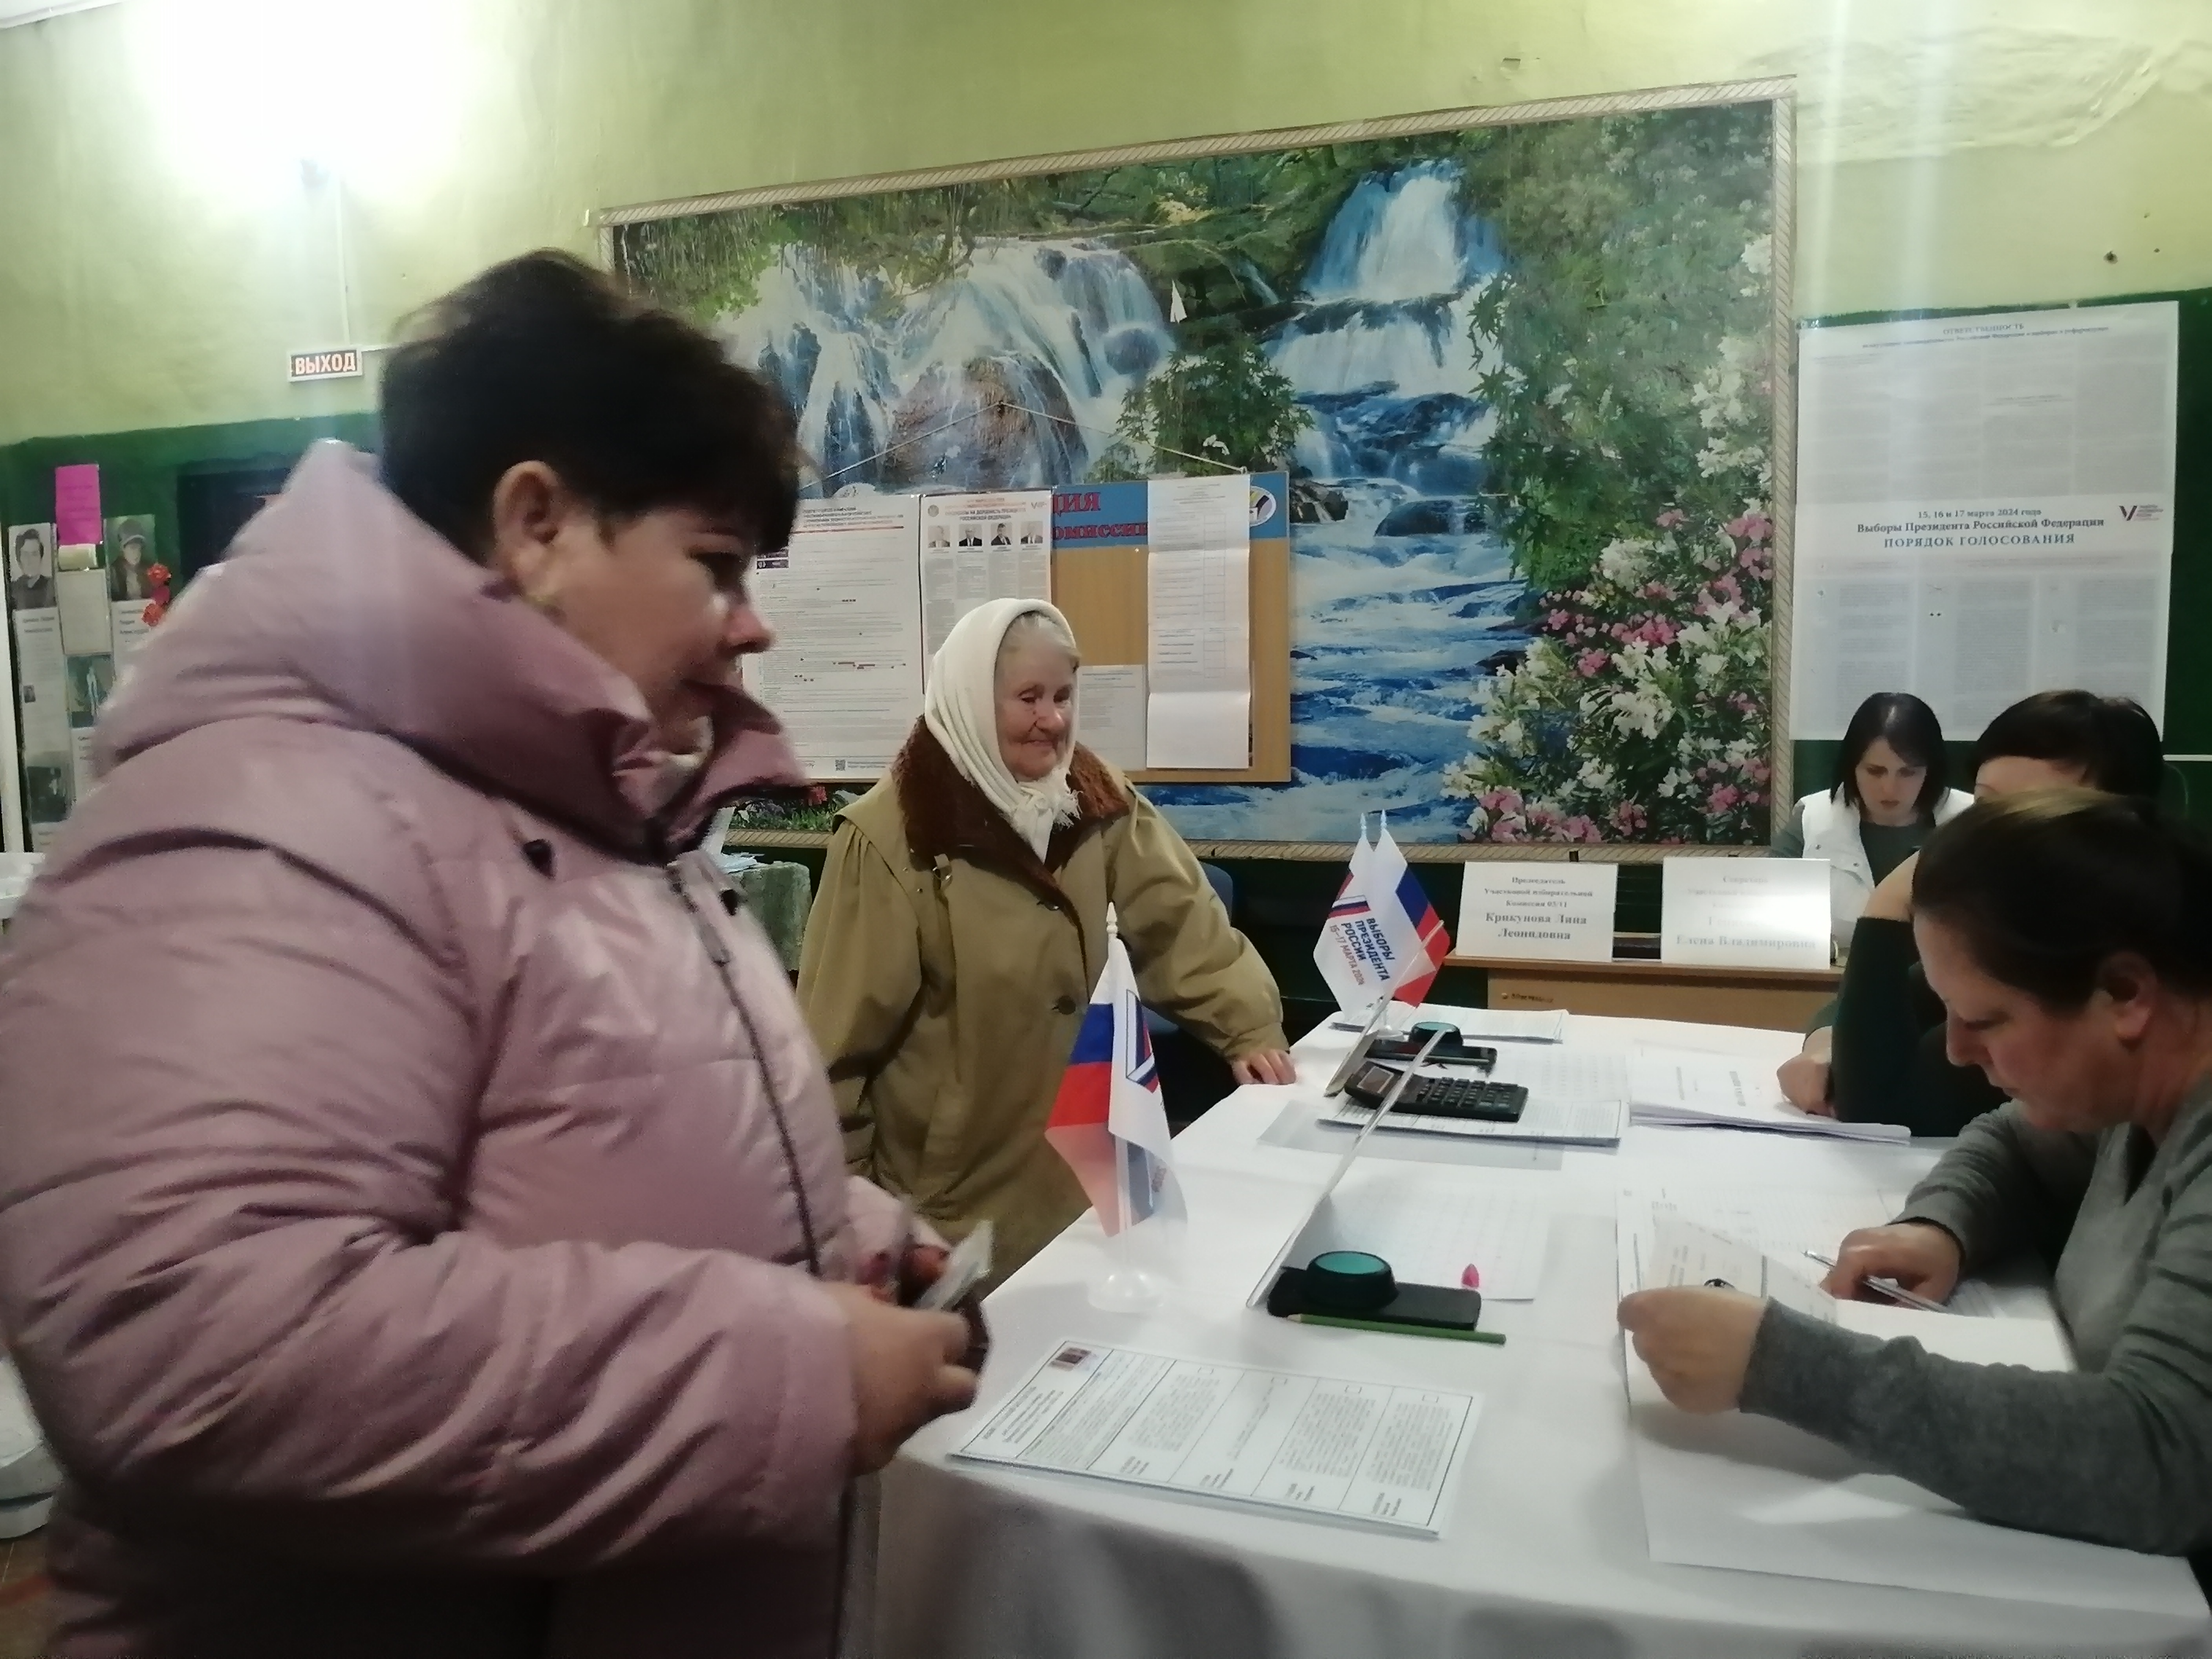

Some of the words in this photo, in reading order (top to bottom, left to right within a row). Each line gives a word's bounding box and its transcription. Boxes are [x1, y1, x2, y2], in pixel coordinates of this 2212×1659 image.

[295, 352, 355, 375] ВЫХОД
[1857, 524, 1902, 534] Выборы
[1906, 522, 1970, 534] Президента
[1973, 520, 2038, 529] Российской
[2042, 519, 2104, 529] Федерации
[1885, 537, 1954, 548] ПОРЯДОК
[1960, 533, 2075, 547] ГОЛОСОВАНИЯ
[1485, 912, 1551, 924] Крикунова
[1341, 922, 1366, 961] РОССИИ
[1366, 917, 1395, 960] ВЫБОРЫ
[1498, 928, 1571, 940] Леонидовна
[1340, 945, 1357, 969] МАРТА
[1355, 920, 1390, 981] ПРЕЗИДЕНТА
